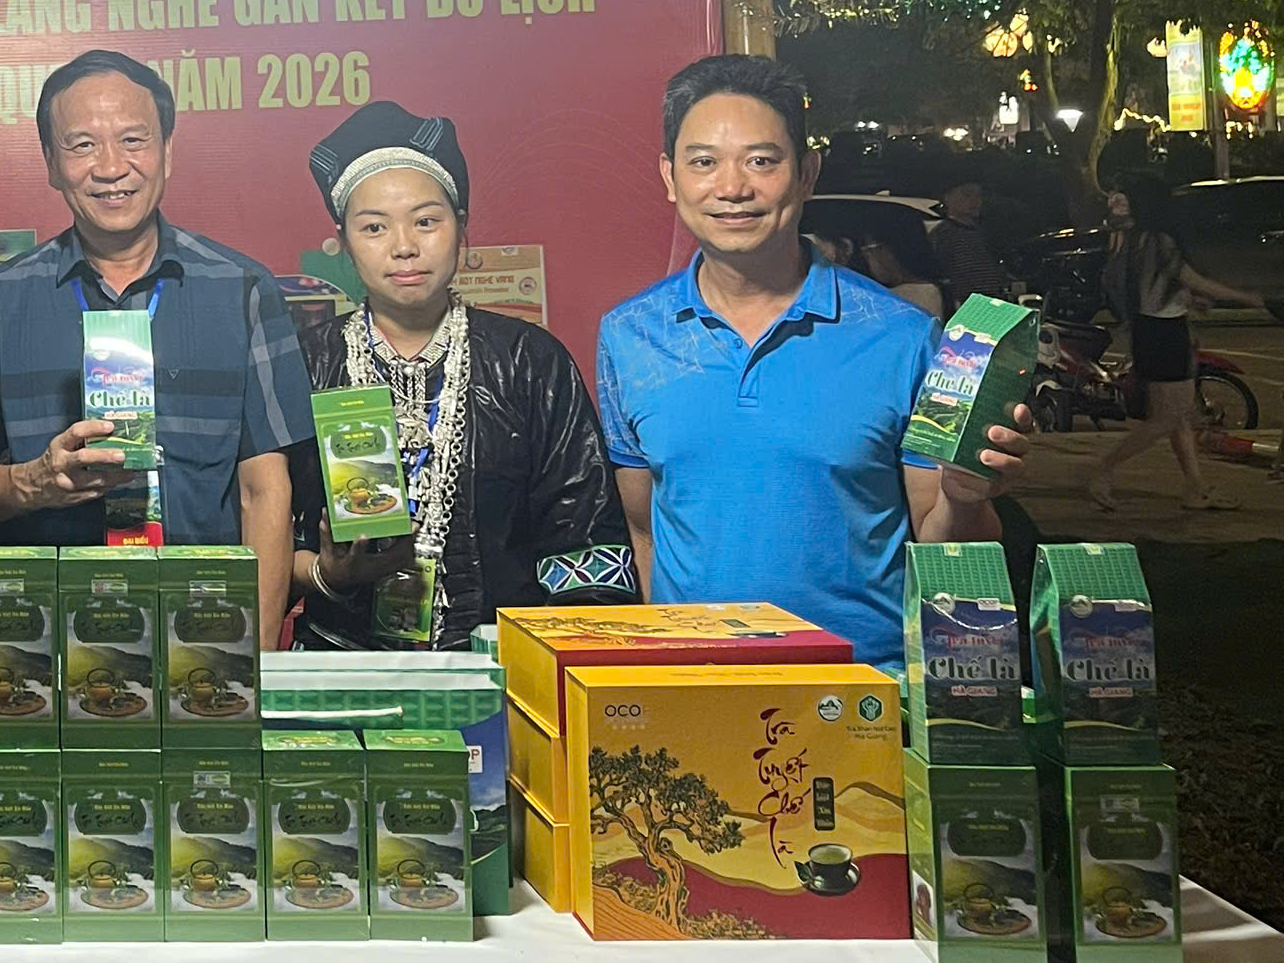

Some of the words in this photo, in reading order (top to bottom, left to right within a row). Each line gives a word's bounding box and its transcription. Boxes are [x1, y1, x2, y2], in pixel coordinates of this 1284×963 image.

[258, 51, 371, 108] 2026
[90, 389, 125, 407] Chế
[133, 390, 150, 405] là
[929, 656, 981, 679] Chế
[990, 658, 1014, 679] là
[1067, 657, 1117, 680] Chế
[1127, 659, 1149, 679] là
[760, 708, 796, 745] Trà
[753, 748, 810, 791] Tuyết
[758, 788, 811, 816] Chế
